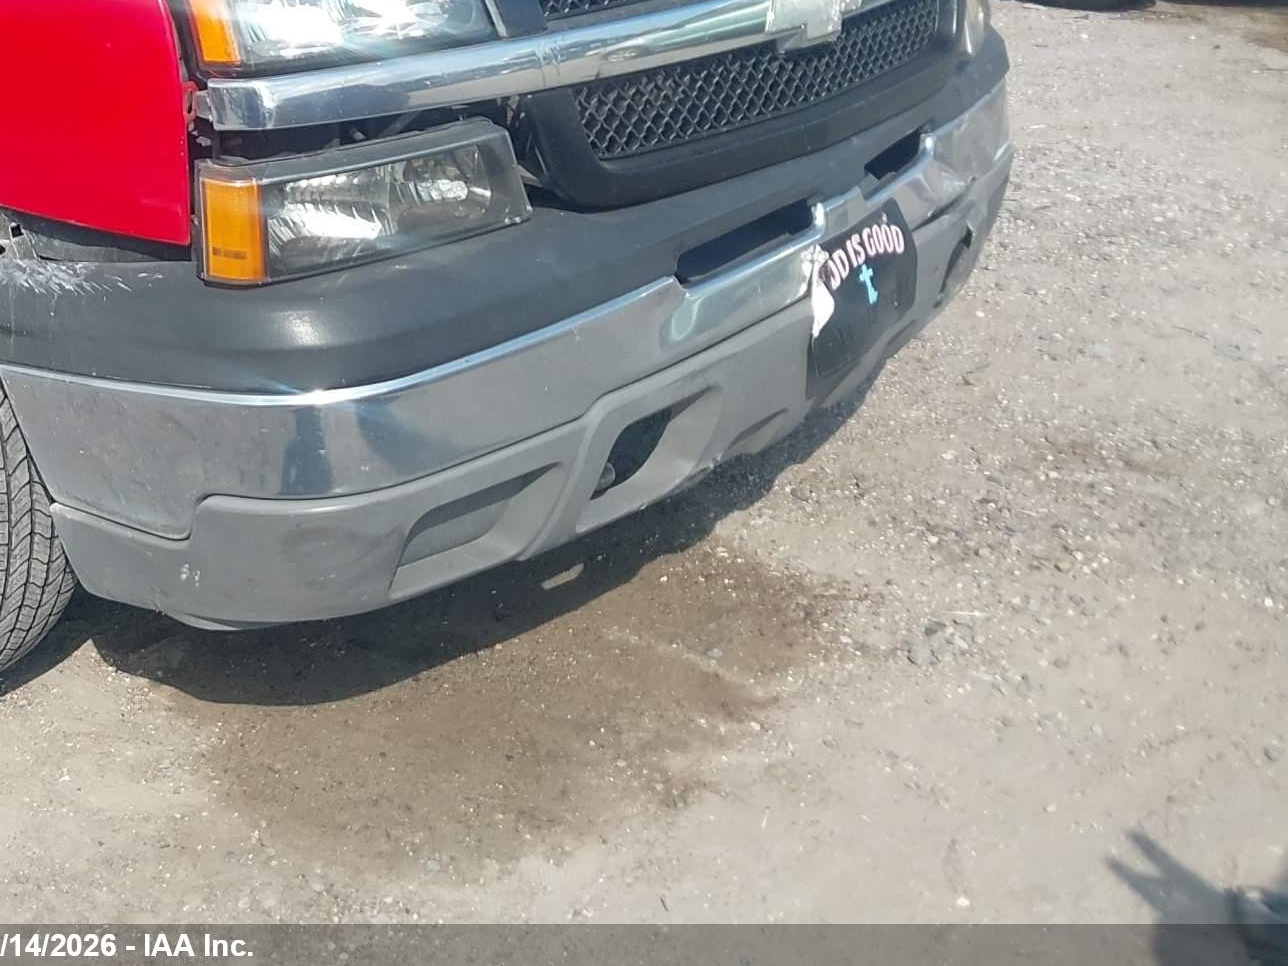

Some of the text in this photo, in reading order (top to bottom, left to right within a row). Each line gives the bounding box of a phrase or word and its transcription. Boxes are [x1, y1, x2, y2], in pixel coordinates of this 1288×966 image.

[826, 224, 905, 290] OD IS GOOD
